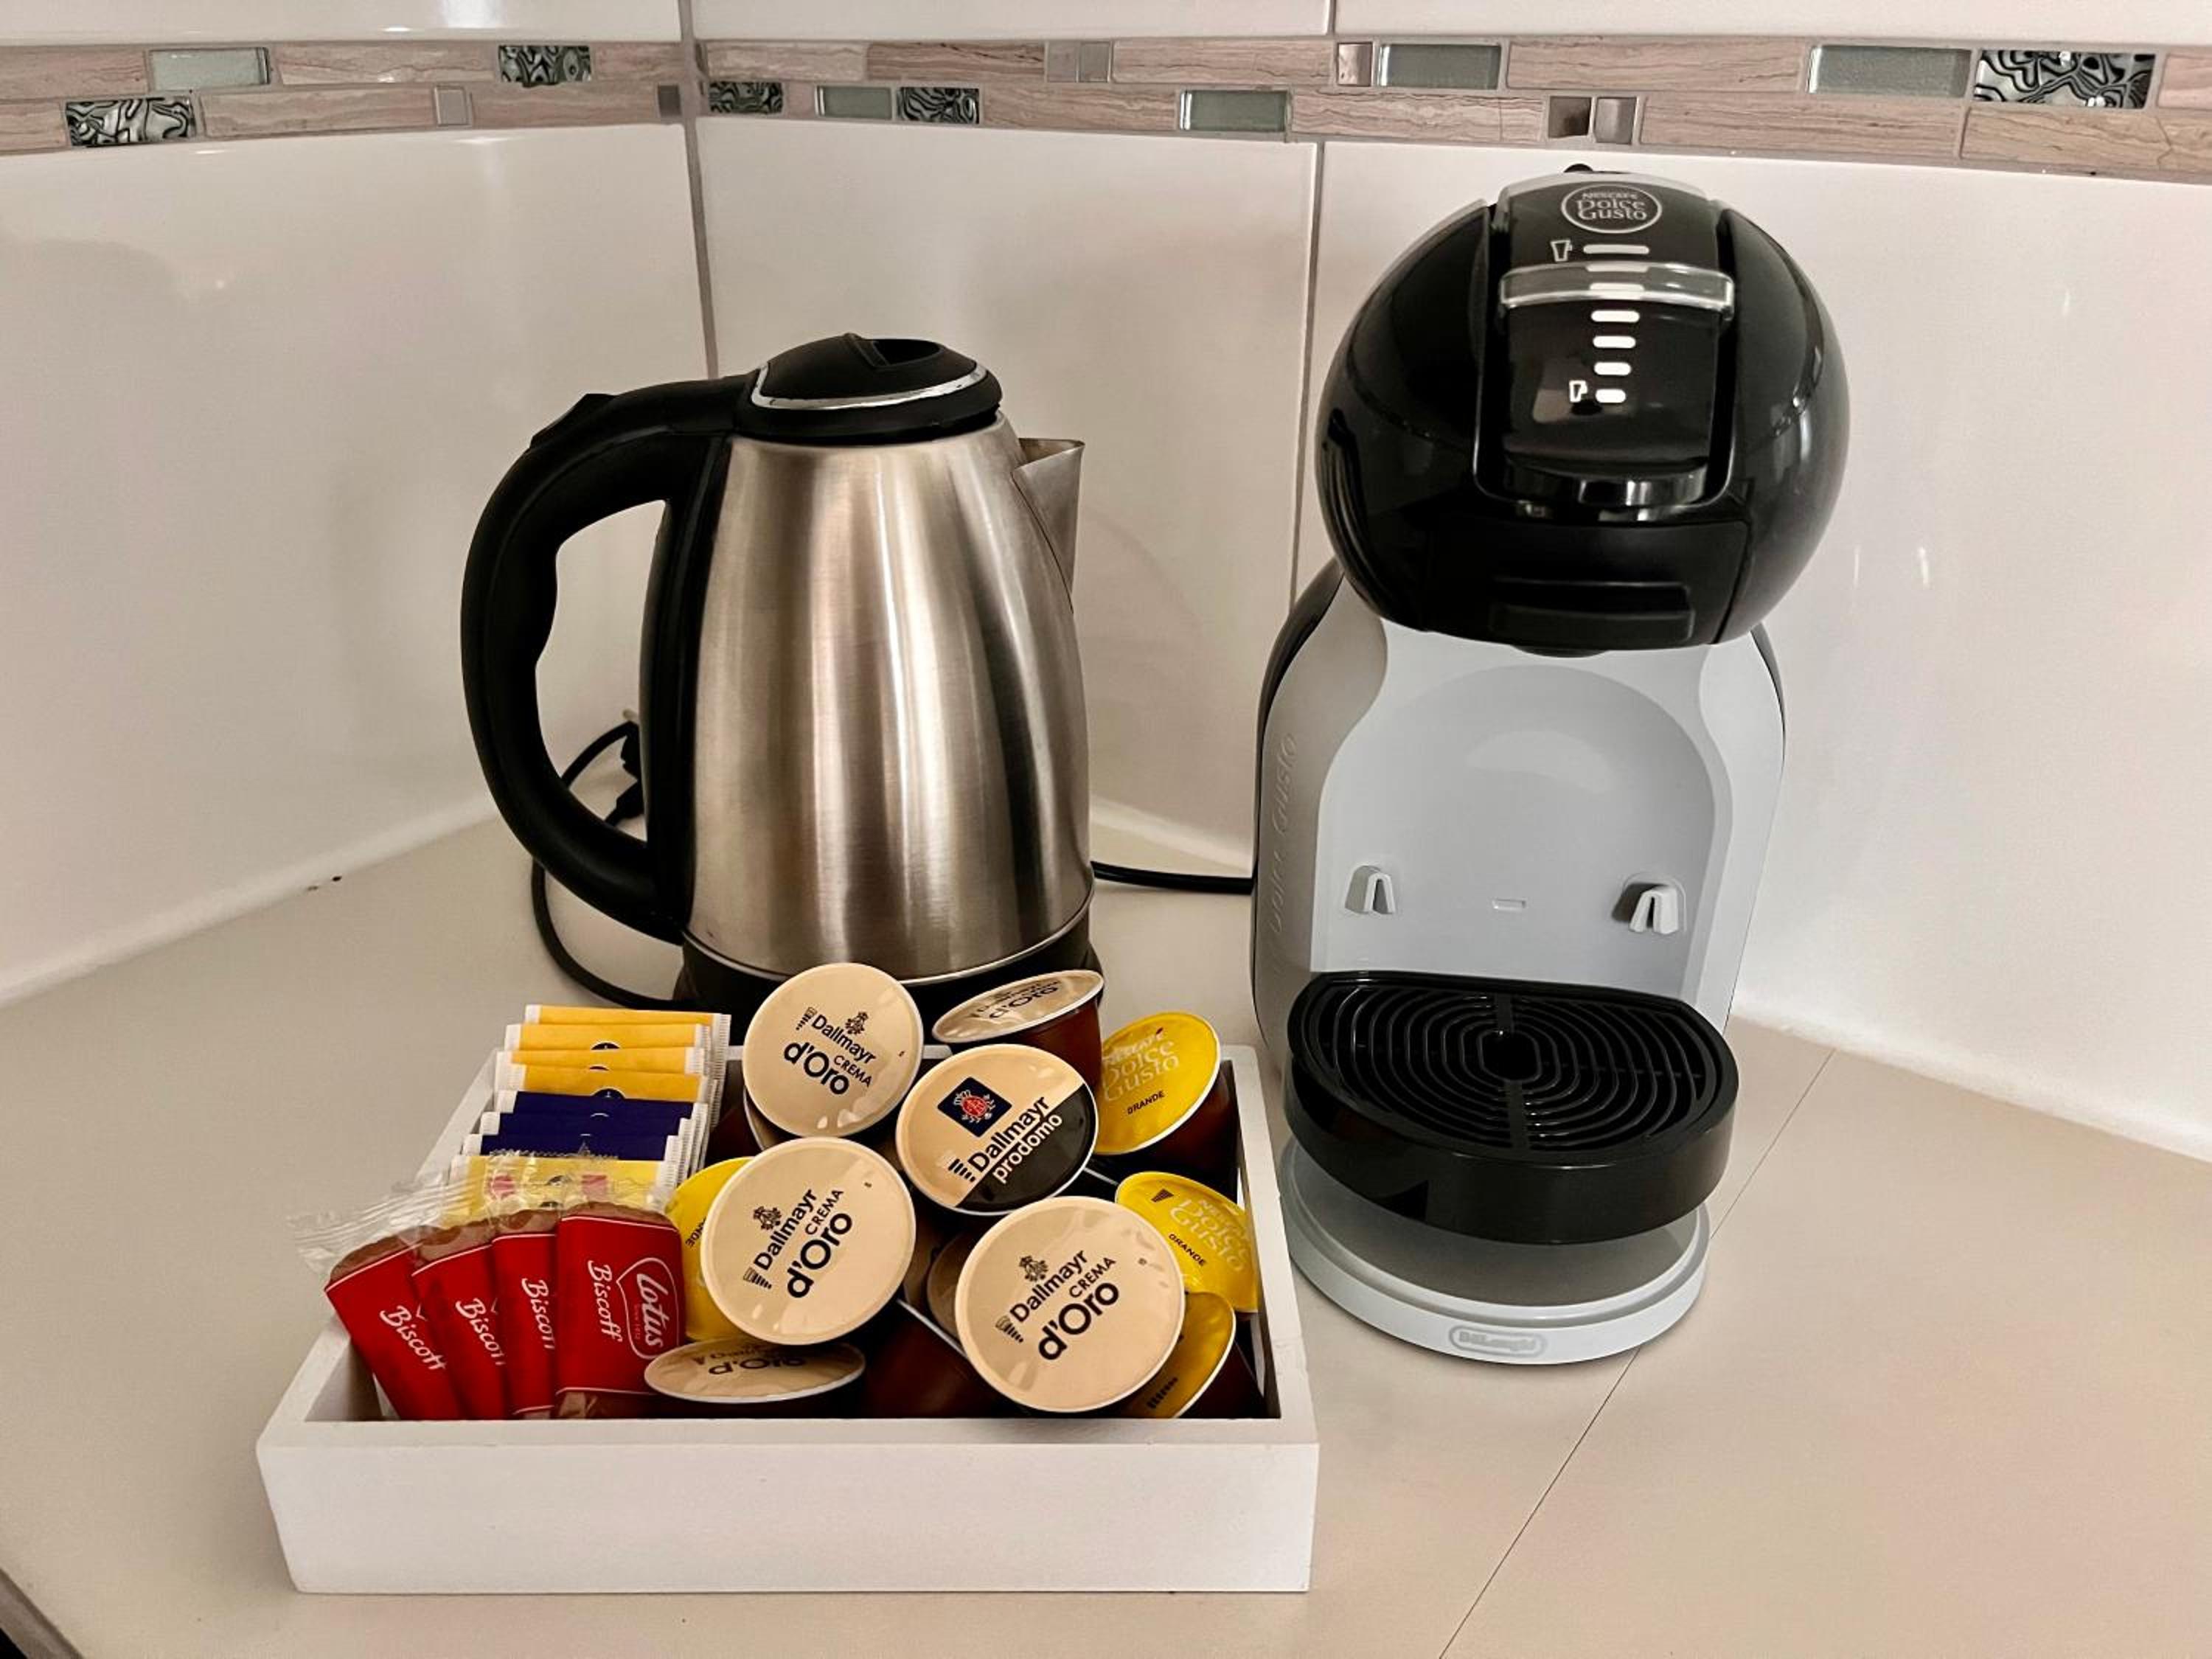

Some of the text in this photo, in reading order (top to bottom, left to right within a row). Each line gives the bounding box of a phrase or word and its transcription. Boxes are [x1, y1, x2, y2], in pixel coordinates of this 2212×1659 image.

[1576, 198, 1646, 210] Dolce
[1578, 208, 1647, 220] Gusto
[811, 1014, 877, 1065] Dallmayr
[783, 1041, 850, 1095] d'Oro
[833, 1055, 874, 1088] CREMA
[1127, 1091, 1165, 1115] GRANDE
[967, 1096, 1050, 1173] Dallmayr
[992, 1114, 1063, 1184] prodomo
[753, 1189, 821, 1271] Dallmayr
[804, 1188, 844, 1236] CREMA
[786, 1212, 853, 1298] d'Oro
[1169, 1233, 1207, 1267] GRANDE
[588, 1259, 623, 1343] Biscoff
[1009, 1250, 1089, 1324] Dallmayr
[1069, 1256, 1117, 1300] CREMA
[1037, 1281, 1120, 1361] d'Oro
